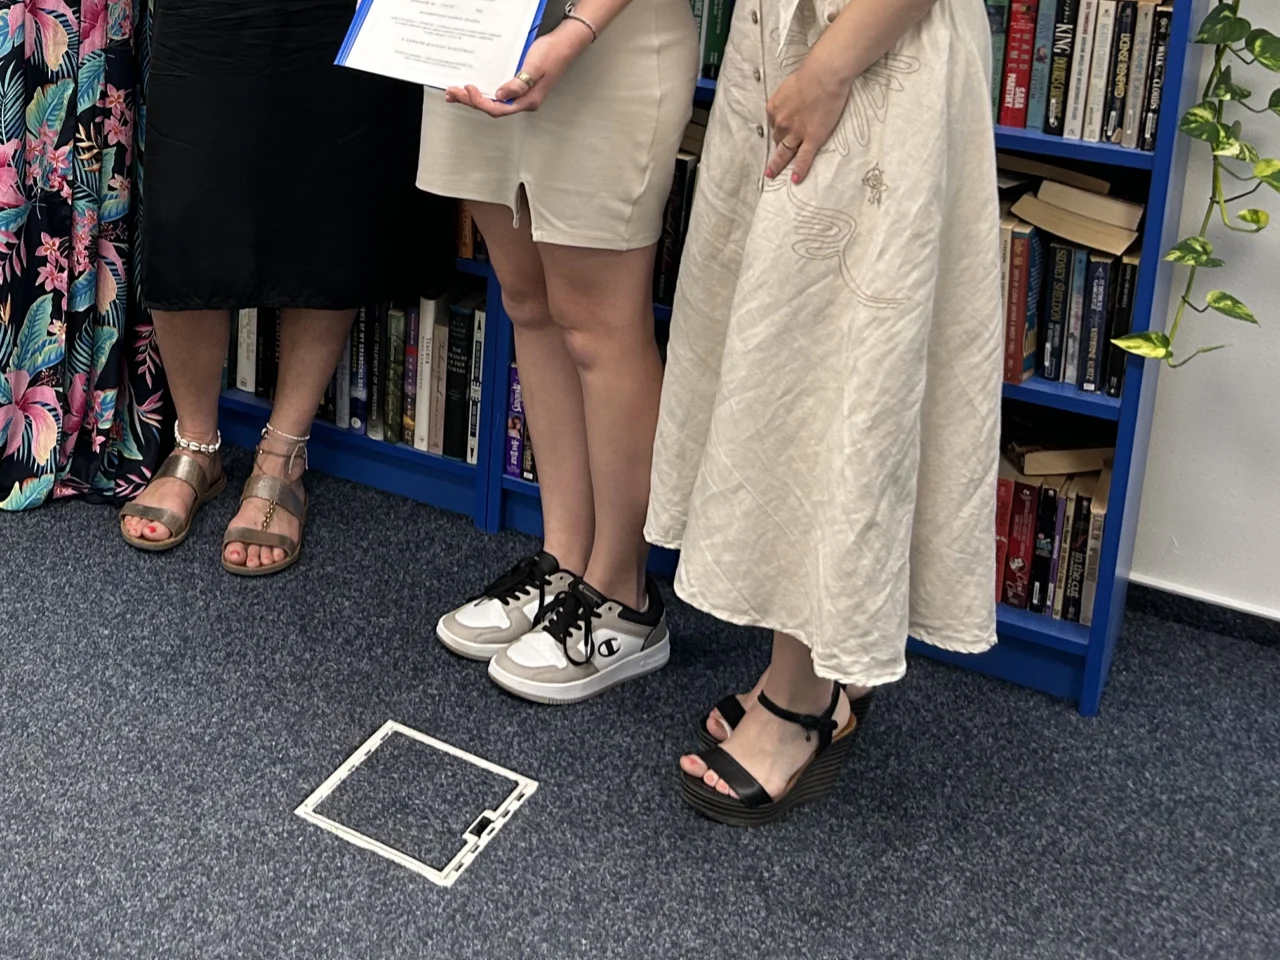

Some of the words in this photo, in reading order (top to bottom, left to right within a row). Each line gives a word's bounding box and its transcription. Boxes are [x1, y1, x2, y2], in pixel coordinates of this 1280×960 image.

[1008, 32, 1021, 69] TIME
[1021, 33, 1031, 71] HARD
[1053, 23, 1073, 54] KING
[1118, 33, 1131, 61] LICENSE
[1154, 45, 1165, 67] WALK
[1004, 73, 1016, 108] PARETSKY
[1114, 63, 1128, 98] RENEWED
[1150, 79, 1161, 110] CLOUDS
[1014, 87, 1026, 108] SARA
[1054, 249, 1067, 281] SIDNEY
[1051, 282, 1065, 321] SHELDON
[1072, 564, 1083, 581] the
[1075, 552, 1083, 563] in
[1070, 582, 1081, 599] cut
